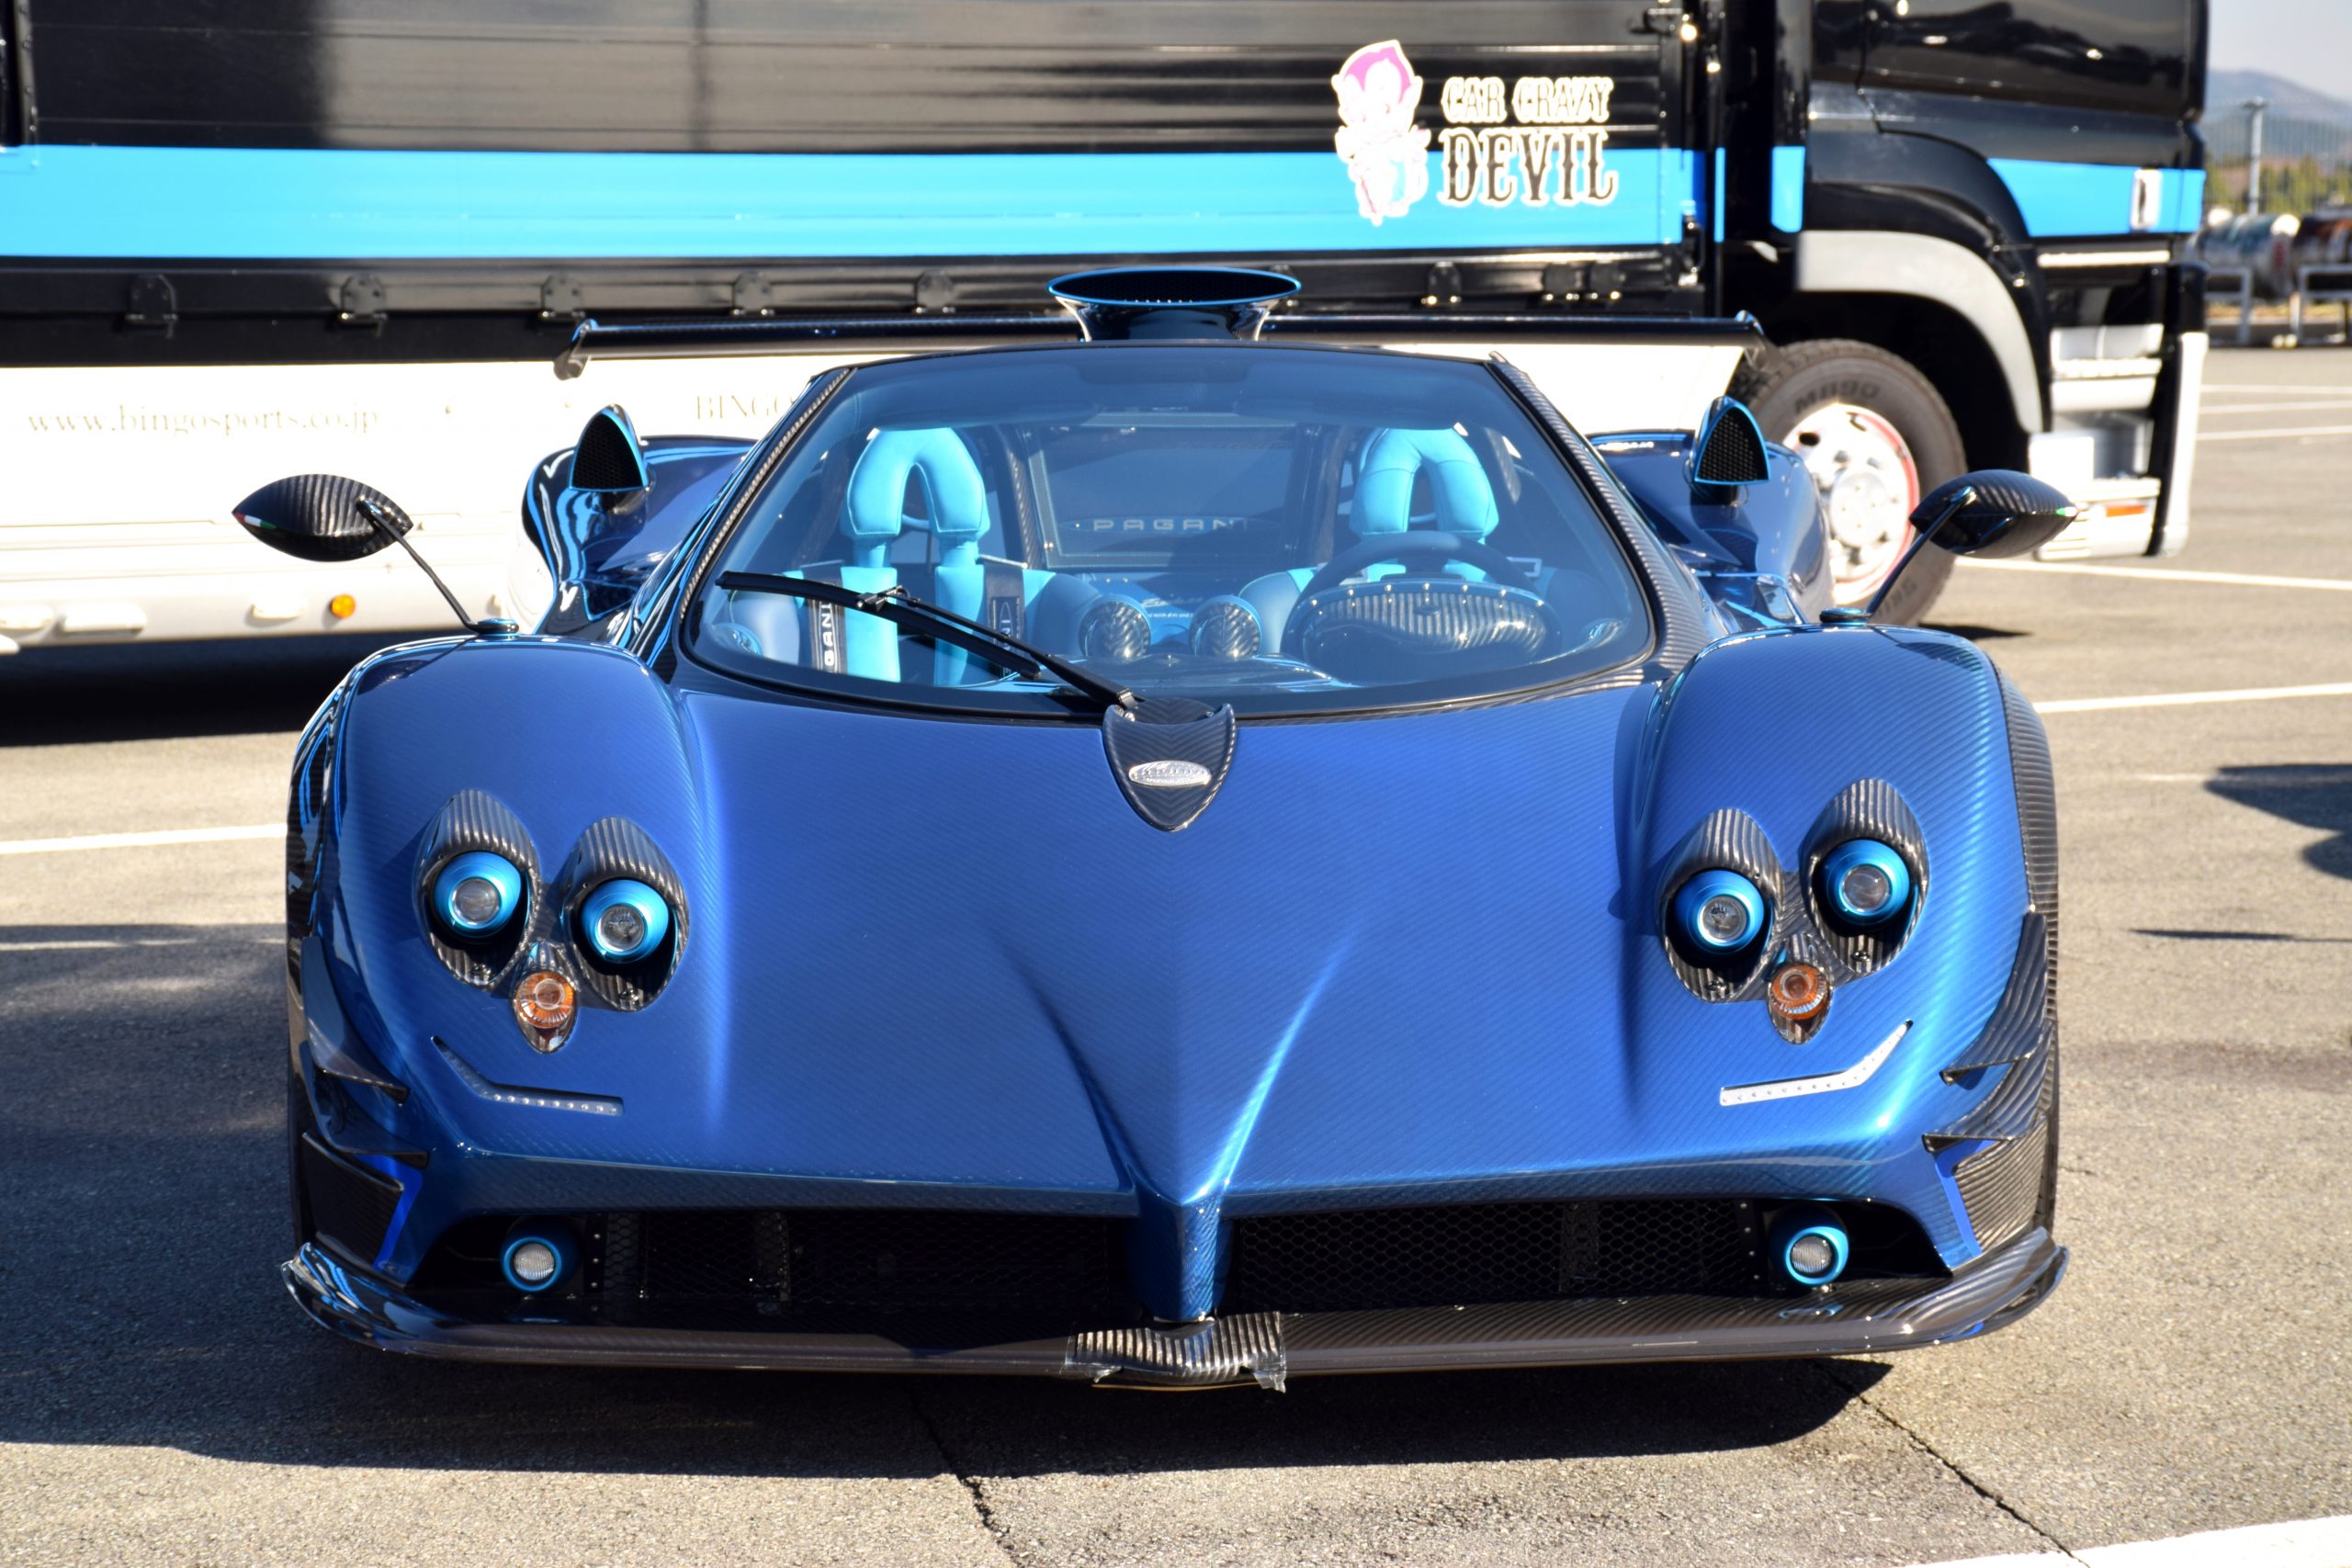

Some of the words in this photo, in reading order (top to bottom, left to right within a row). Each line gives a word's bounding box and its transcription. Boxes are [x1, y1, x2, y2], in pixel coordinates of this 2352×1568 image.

[1442, 78, 1507, 122] CAR
[1513, 78, 1613, 122] CRAZY
[1440, 129, 1617, 204] DEVIL
[28, 401, 379, 436] www.bingosports.co.jp
